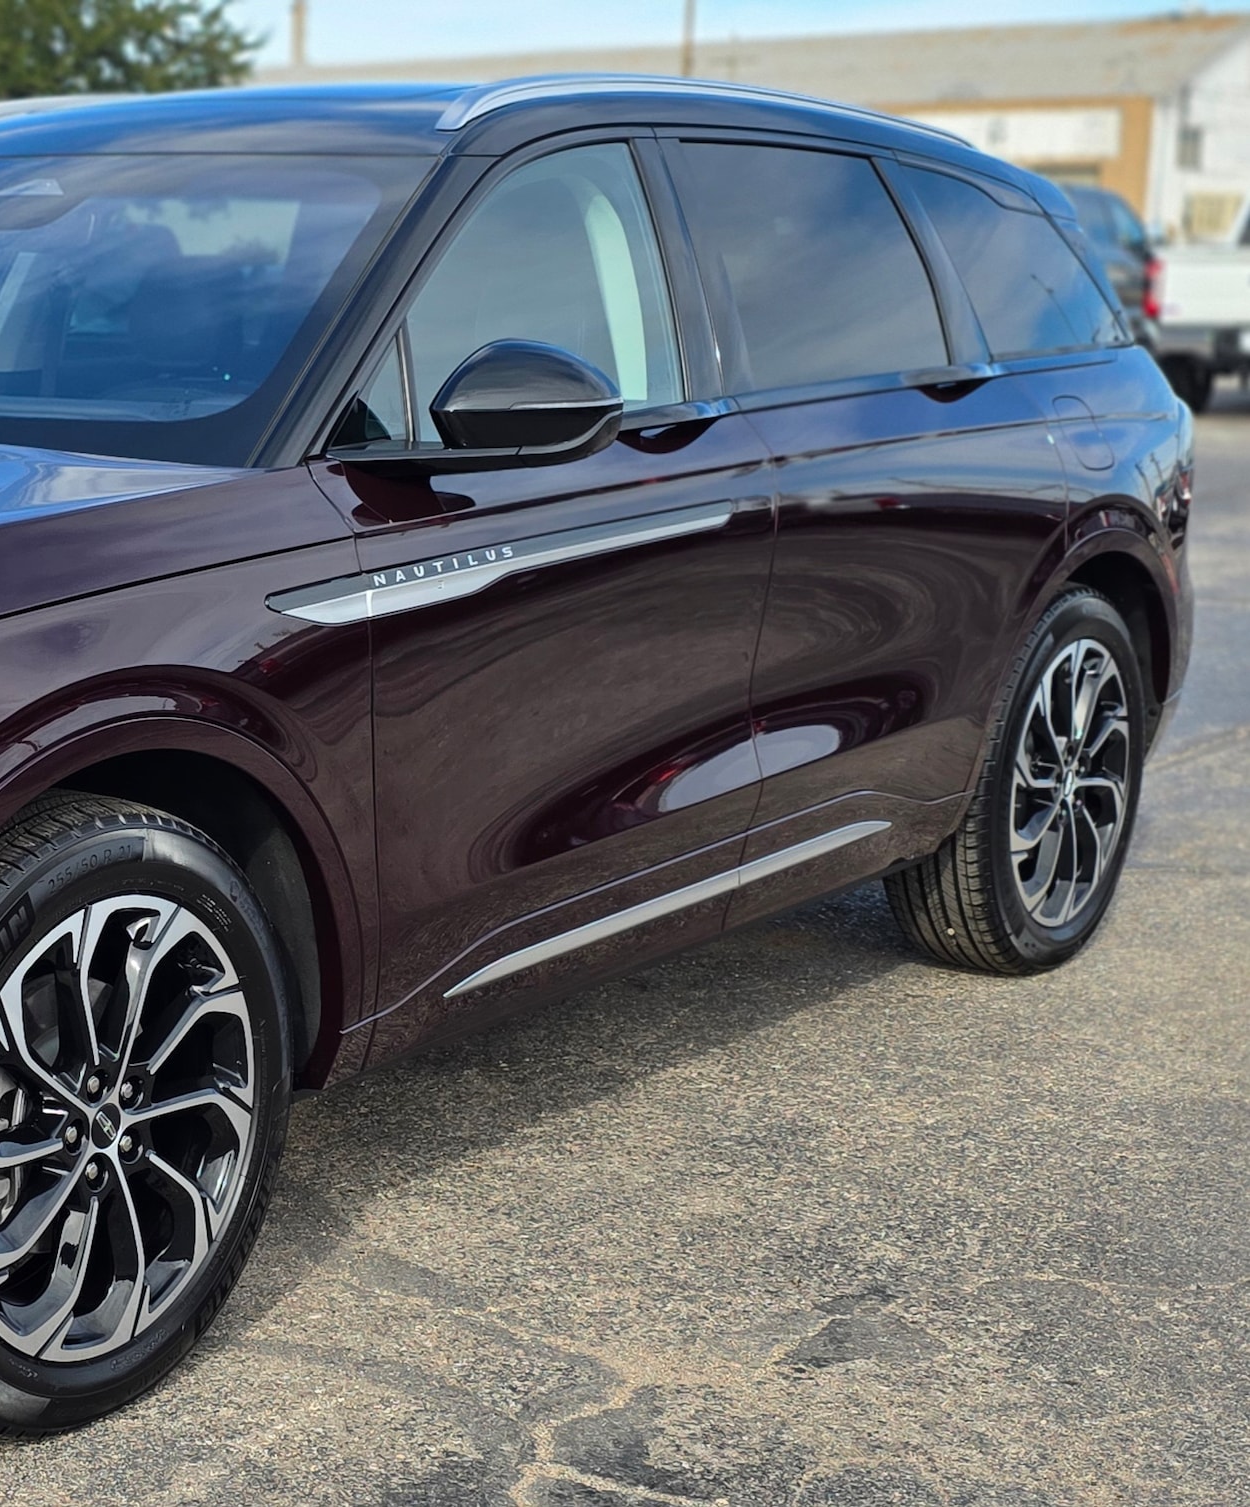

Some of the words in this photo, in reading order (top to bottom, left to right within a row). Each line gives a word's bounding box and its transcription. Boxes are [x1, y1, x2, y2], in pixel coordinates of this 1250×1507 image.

[373, 546, 514, 587] NAUTILUS
[47, 853, 98, 895] 255/50
[102, 848, 113, 865] R
[118, 844, 133, 860] 21
